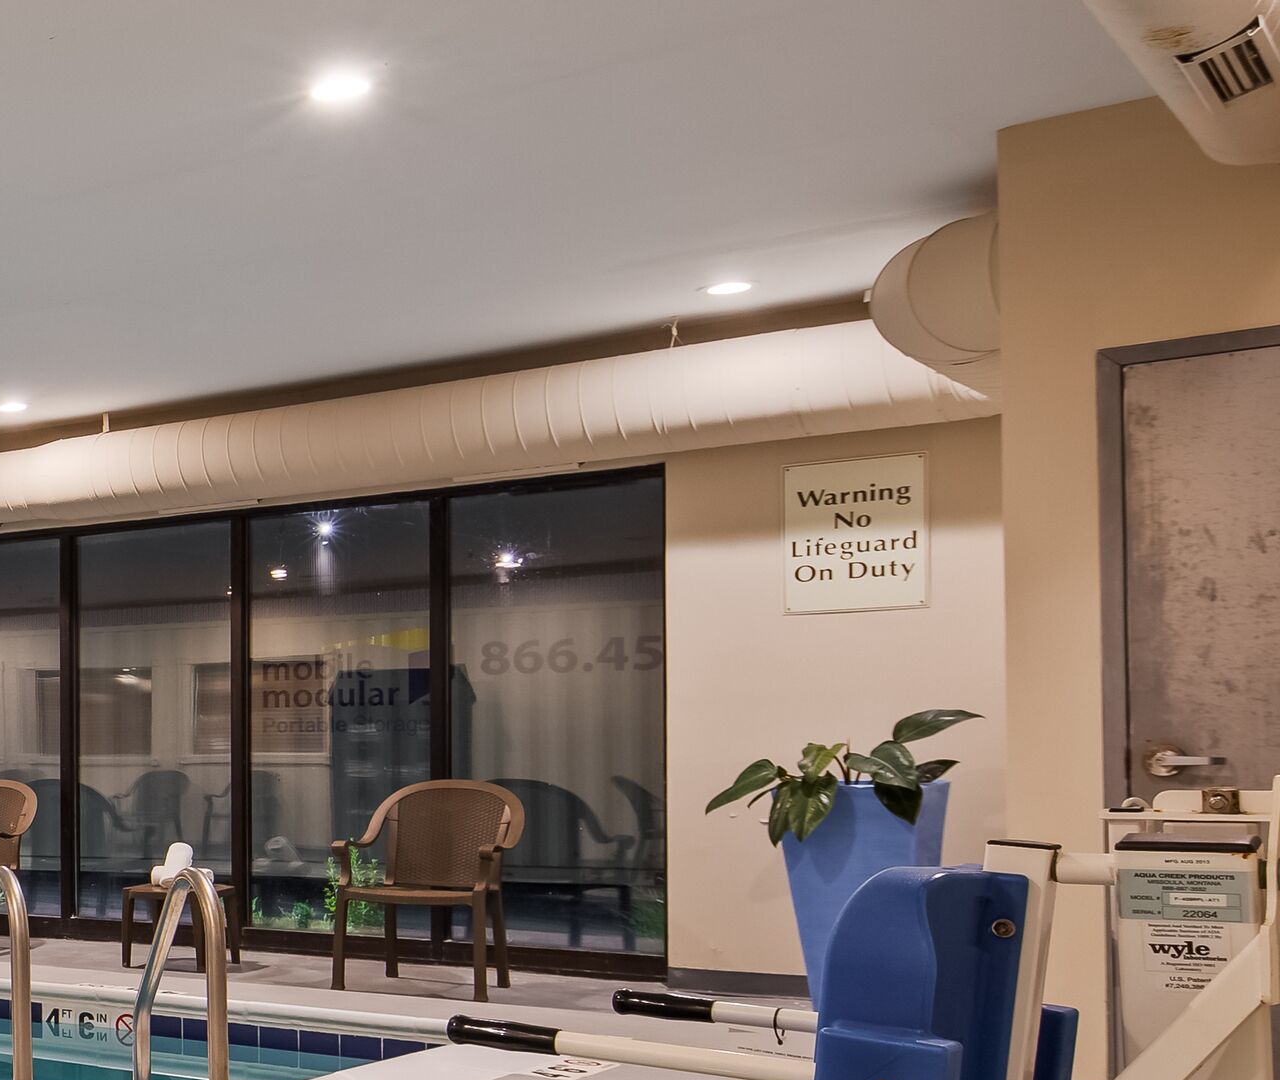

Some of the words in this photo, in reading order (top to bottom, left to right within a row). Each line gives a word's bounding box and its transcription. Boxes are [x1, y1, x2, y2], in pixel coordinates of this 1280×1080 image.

[797, 483, 911, 507] Warning
[834, 511, 871, 529] No
[792, 530, 917, 560] Lifeguard
[795, 565, 833, 582] On
[848, 560, 915, 582] Duty
[262, 654, 374, 682] mobile
[262, 681, 400, 708] modular
[262, 717, 346, 734] Portable
[1182, 910, 1218, 918] 22064
[1148, 941, 1210, 959] wyle
[62, 1009, 72, 1019] FT
[97, 1013, 107, 1023] IN
